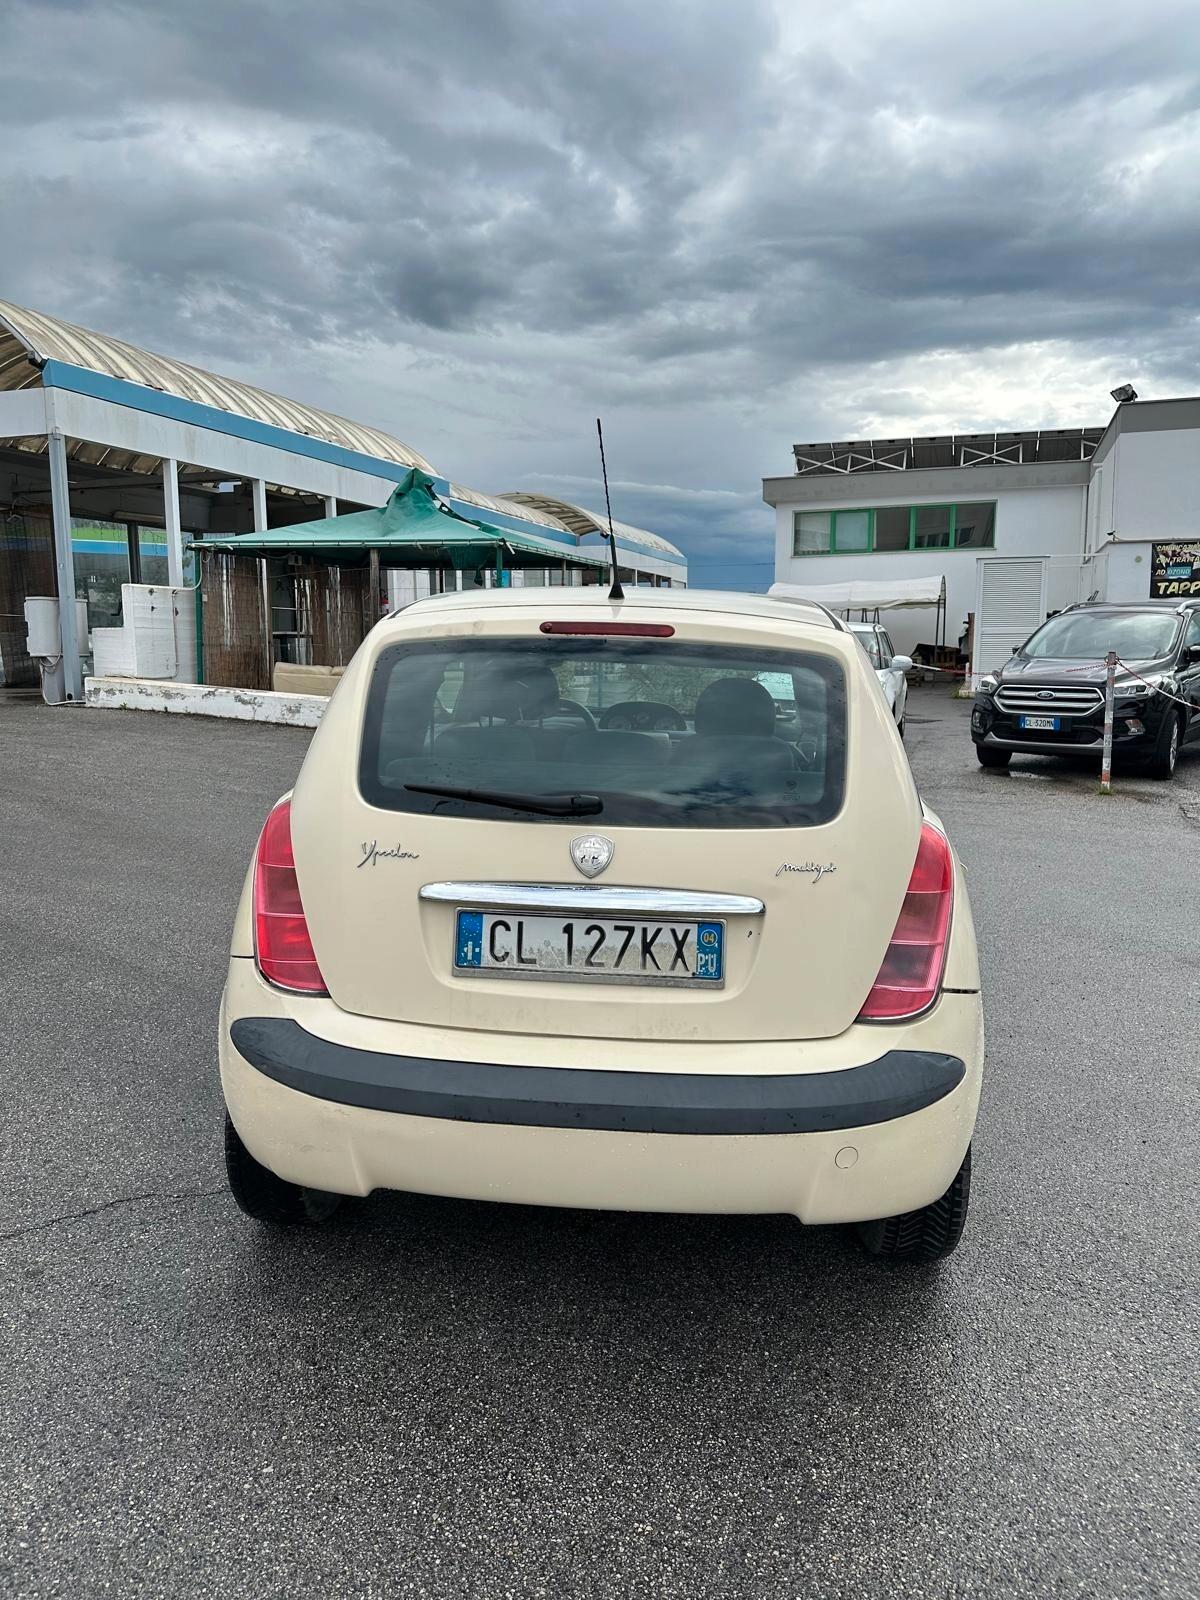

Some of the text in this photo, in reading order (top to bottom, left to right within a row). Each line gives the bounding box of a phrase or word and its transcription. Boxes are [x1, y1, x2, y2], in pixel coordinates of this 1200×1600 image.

[1157, 581, 1200, 595] TAPP
[357, 840, 420, 868] Ypsilon
[489, 919, 691, 972] CL 127KX
[703, 932, 715, 943] 04
[697, 952, 717, 973] PU
